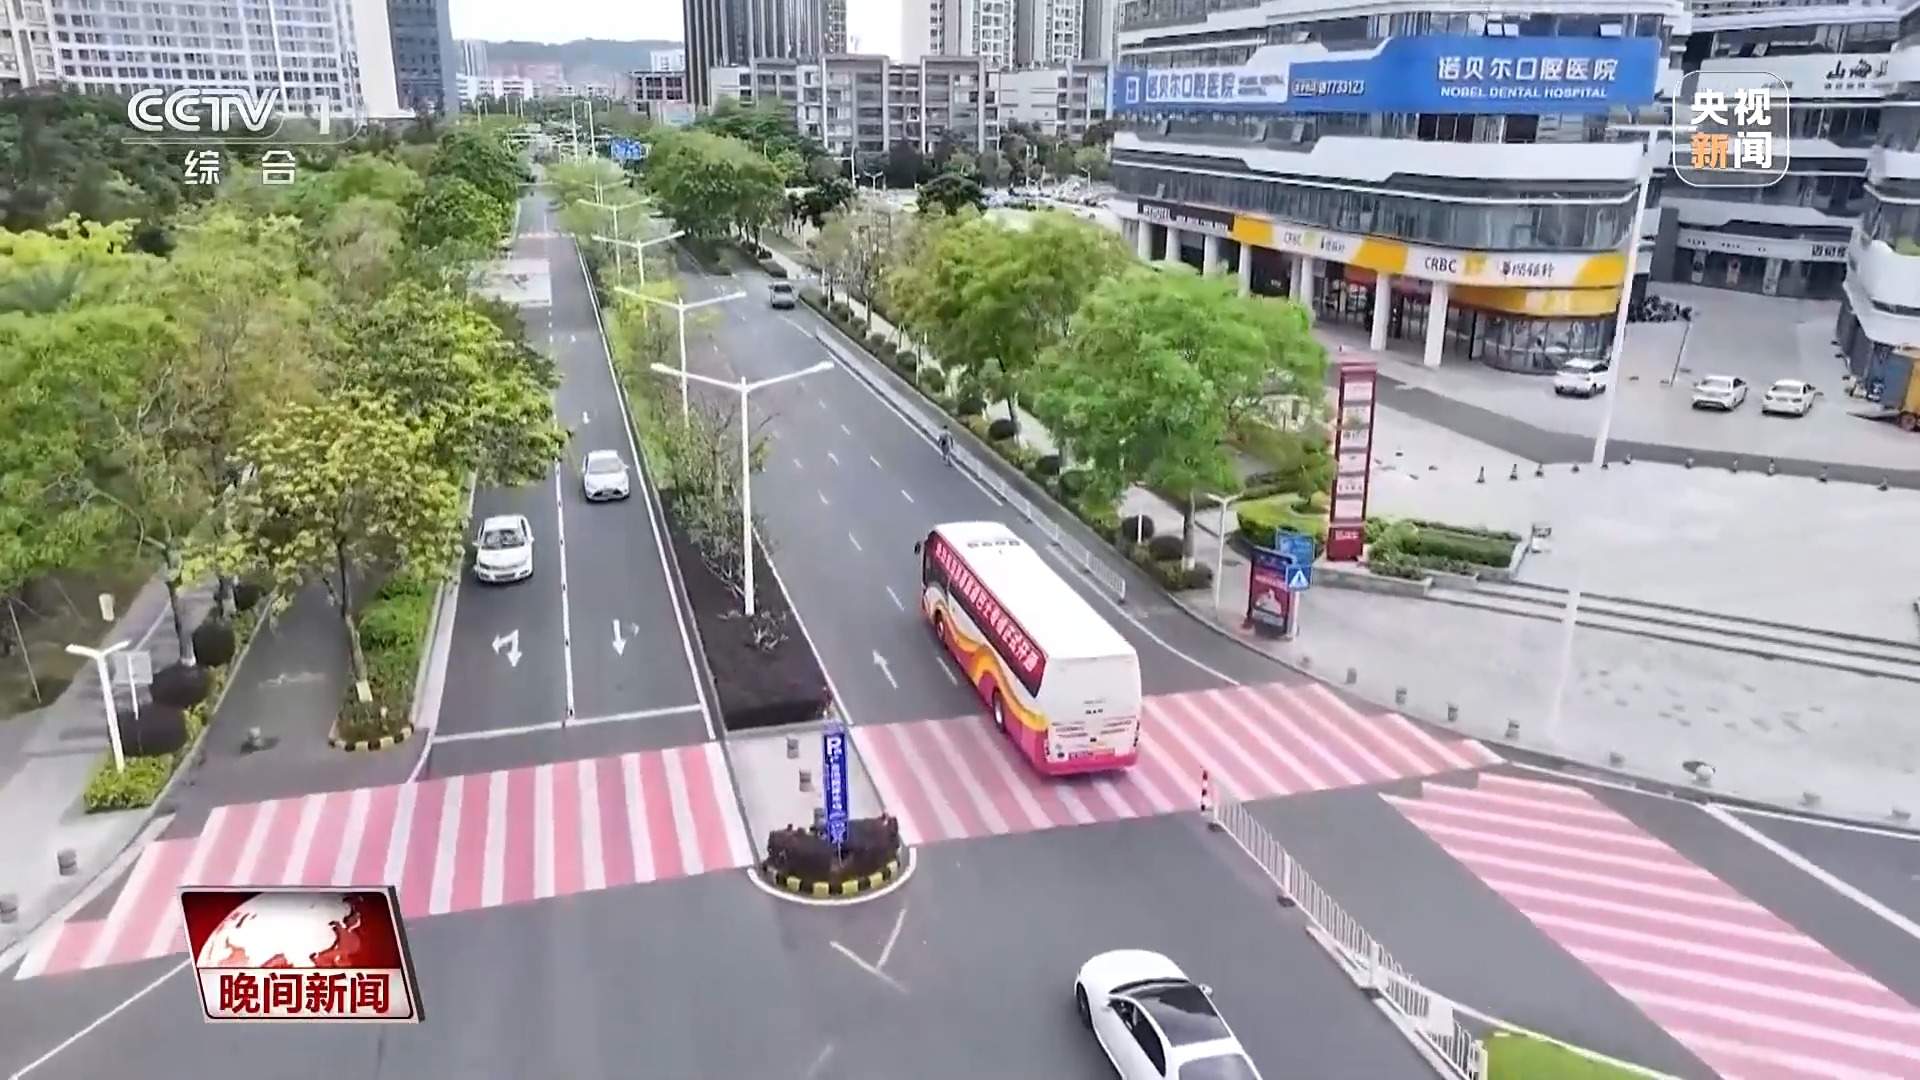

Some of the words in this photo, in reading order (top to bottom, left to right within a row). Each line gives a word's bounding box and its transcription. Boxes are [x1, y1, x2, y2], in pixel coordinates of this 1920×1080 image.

[1438, 56, 1618, 81] 诺贝尔口腔医院
[1440, 86, 1485, 98] NOBEL
[1489, 86, 1542, 98] DENTAL
[1544, 86, 1608, 98] HOSPITAL
[1424, 256, 1457, 274] CRBC
